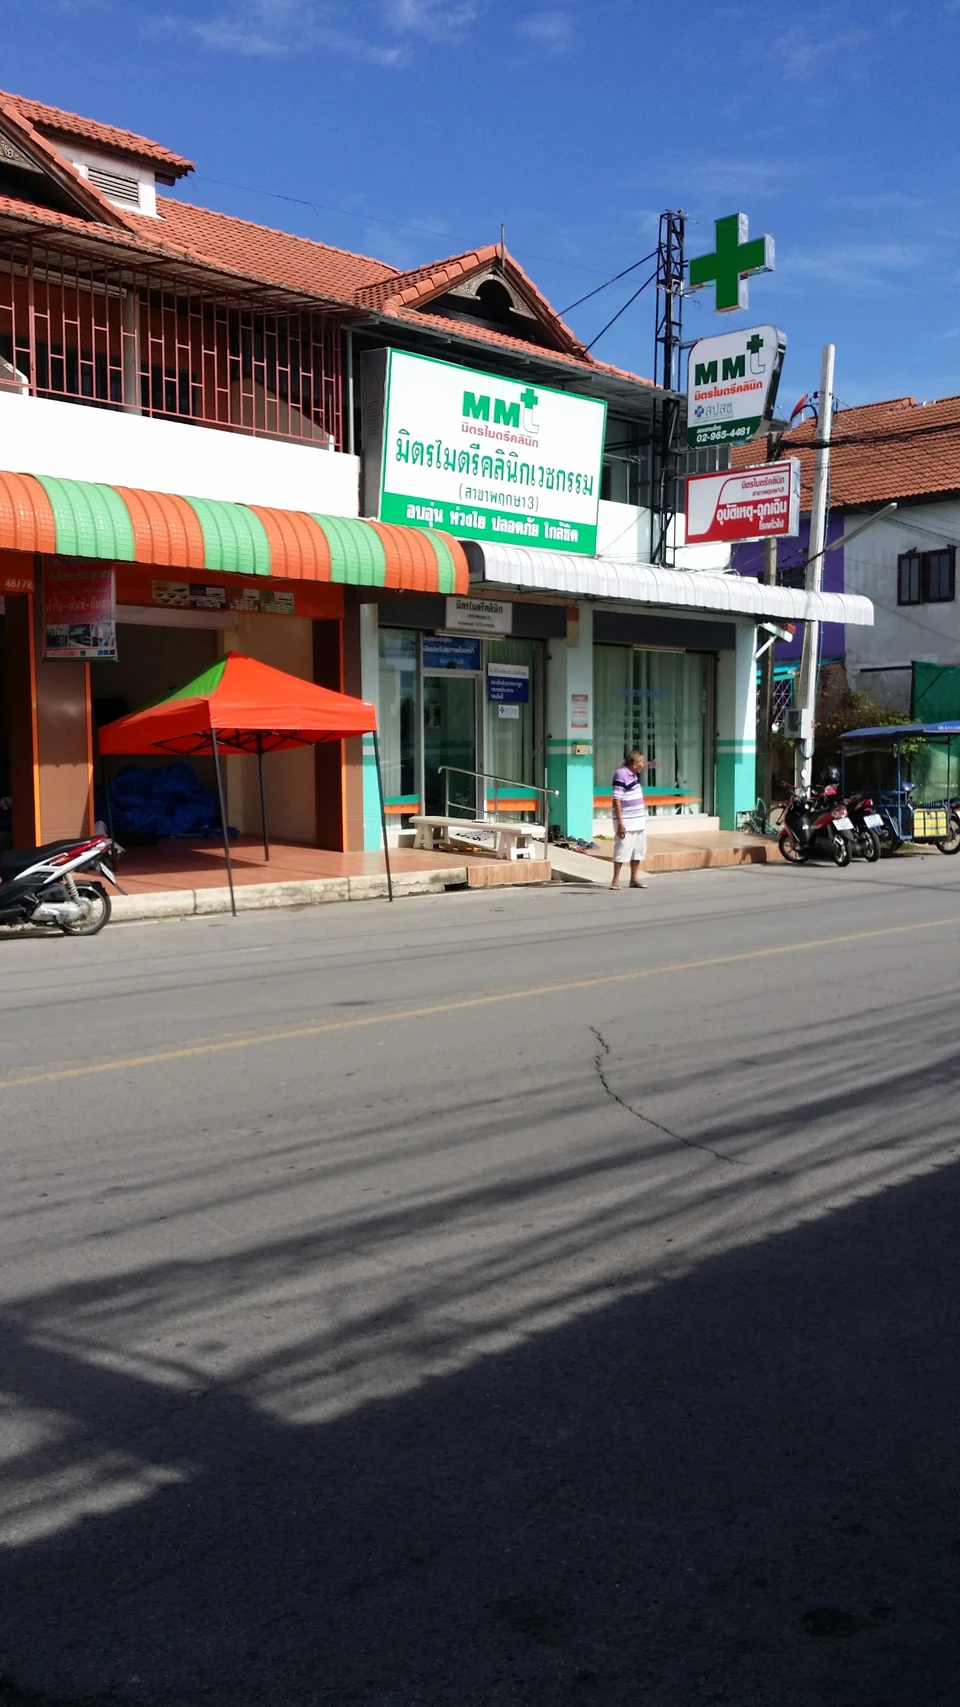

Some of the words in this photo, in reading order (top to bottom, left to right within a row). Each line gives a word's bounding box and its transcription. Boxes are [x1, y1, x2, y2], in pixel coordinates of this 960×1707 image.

[694, 379, 763, 401] มิตรไมตรีคลินิก
[461, 421, 539, 448] มิตรไมตรีคลินิก
[395, 428, 594, 497] มิตรไมตรีคลินิกเวชกรรม
[458, 483, 539, 513] (สาขาพฤกษา3)
[716, 498, 788, 526] อุบัติเหตุ-ฉุกเฉิน
[406, 502, 443, 529] อบอุ่น
[449, 506, 486, 530] ห่วงใย
[491, 515, 539, 538] ปลอดภัย
[544, 521, 579, 543] ใกล้ชิด
[5, 578, 33, 589] 46/72
